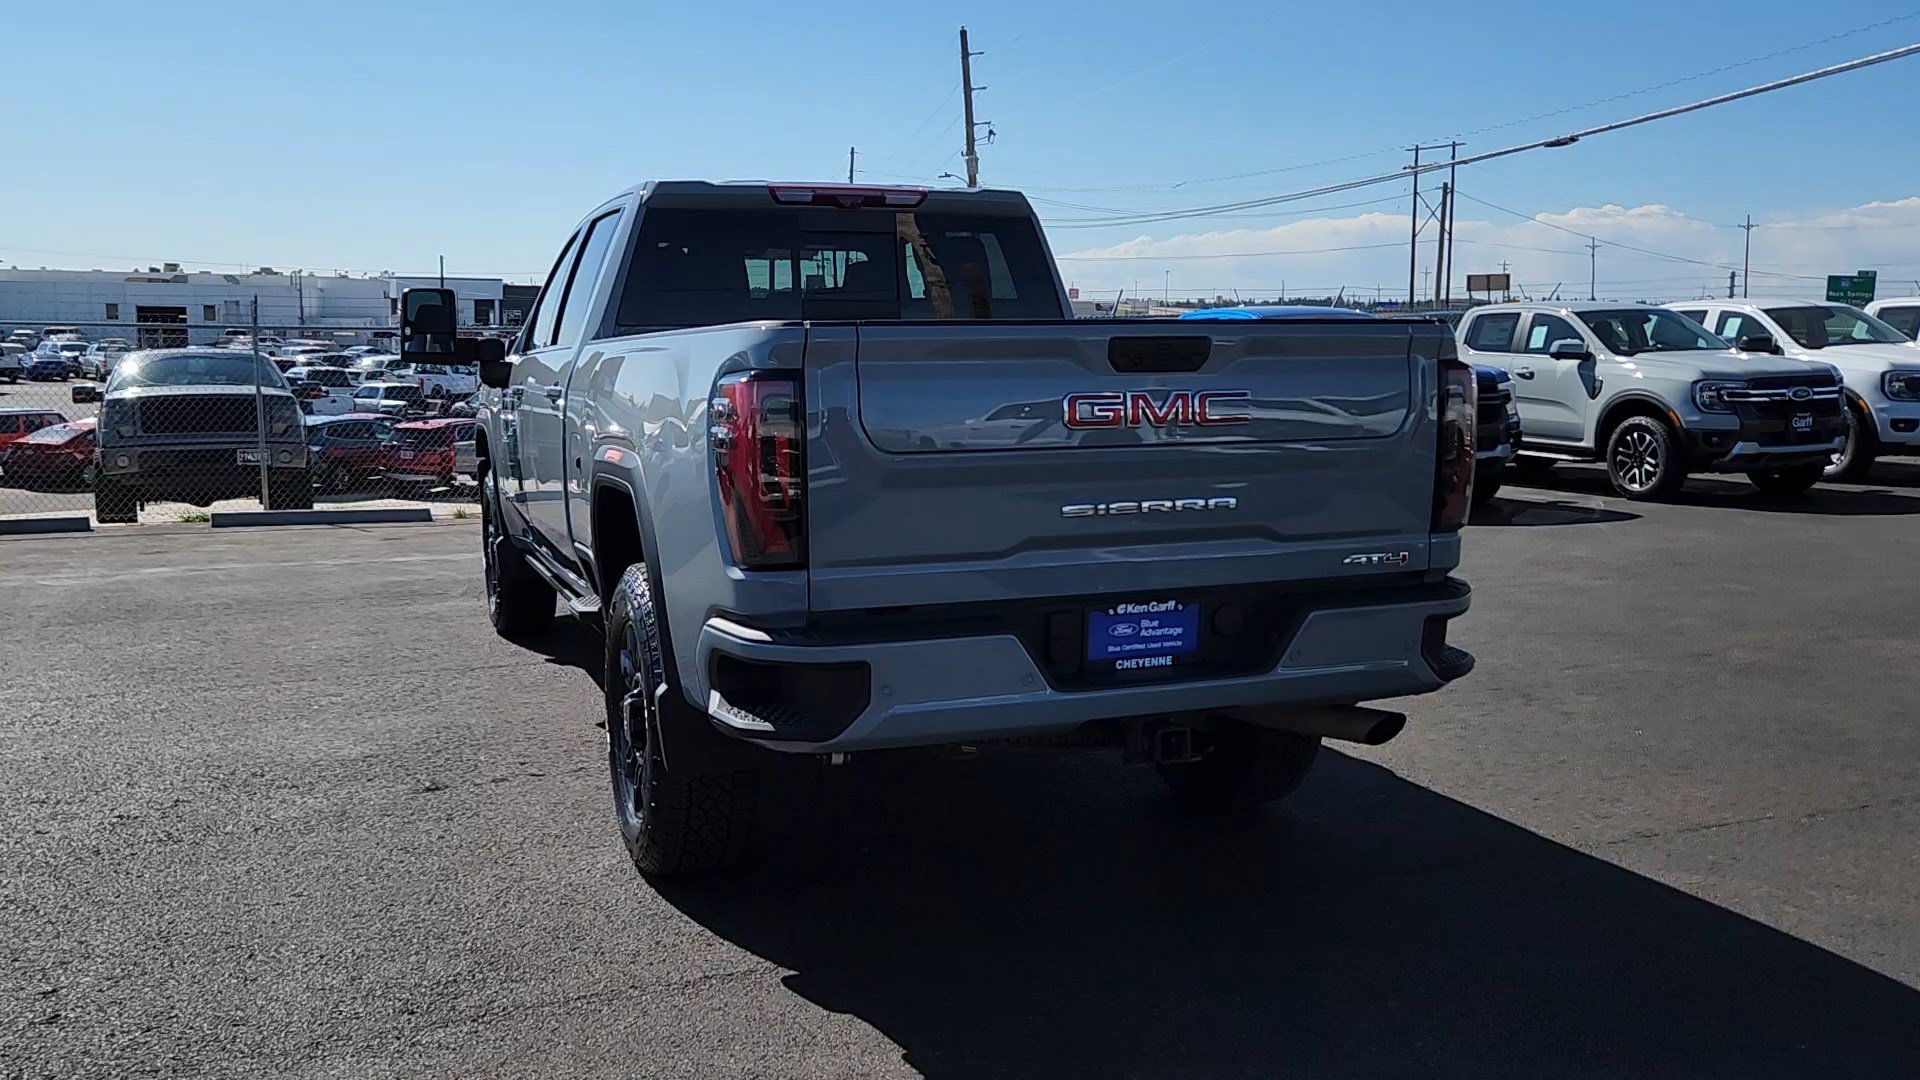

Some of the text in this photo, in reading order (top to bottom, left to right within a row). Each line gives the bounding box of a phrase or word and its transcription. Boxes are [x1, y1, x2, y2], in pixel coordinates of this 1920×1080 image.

[1063, 390, 1252, 430] GMC
[1792, 416, 1813, 428] Garff
[1061, 497, 1237, 518] SIERRA
[1343, 551, 1409, 566] AT4
[1127, 600, 1176, 614] Ken Garff
[1114, 625, 1134, 635] Ford
[1140, 619, 1159, 628] Blue
[1140, 627, 1183, 637] Advantage
[1122, 643, 1146, 651] Certified
[1147, 641, 1162, 649] Used
[1163, 640, 1183, 648] Vehicle
[1116, 656, 1173, 670] CHEYENNE
